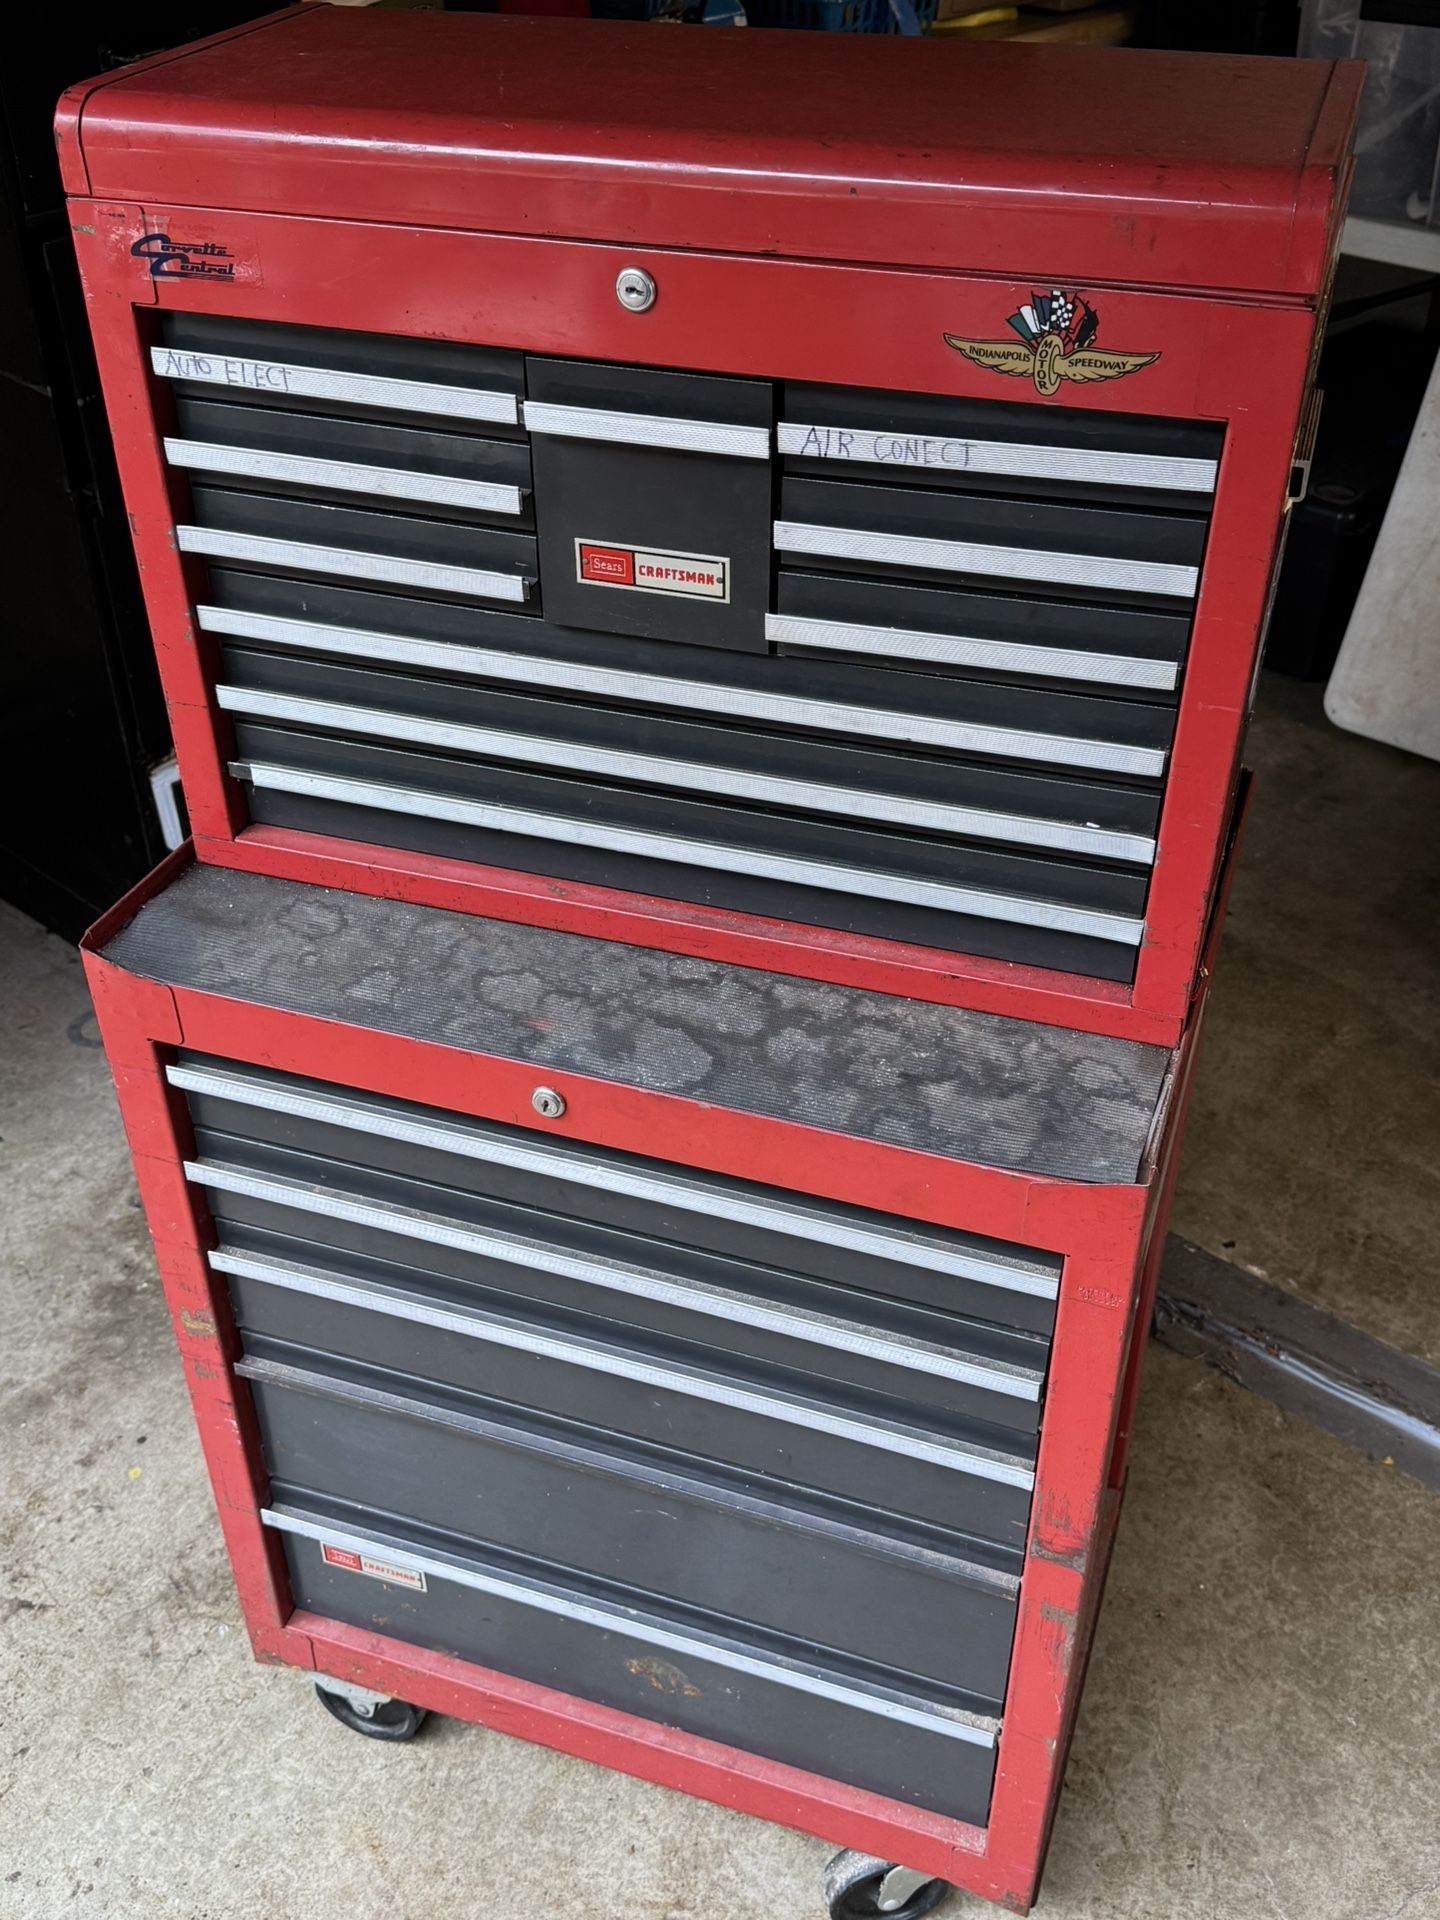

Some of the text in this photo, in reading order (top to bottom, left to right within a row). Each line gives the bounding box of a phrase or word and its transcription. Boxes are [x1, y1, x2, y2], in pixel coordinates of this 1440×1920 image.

[131, 233, 230, 257] Corvette
[150, 253, 235, 279] Central
[225, 359, 292, 392] ELECT
[969, 340, 1129, 390] INDIANAPOLIS MOTOR SPEEDWAY
[800, 425, 978, 467] AIR CONECT
[593, 558, 715, 585] Sears CRAFTSMAN
